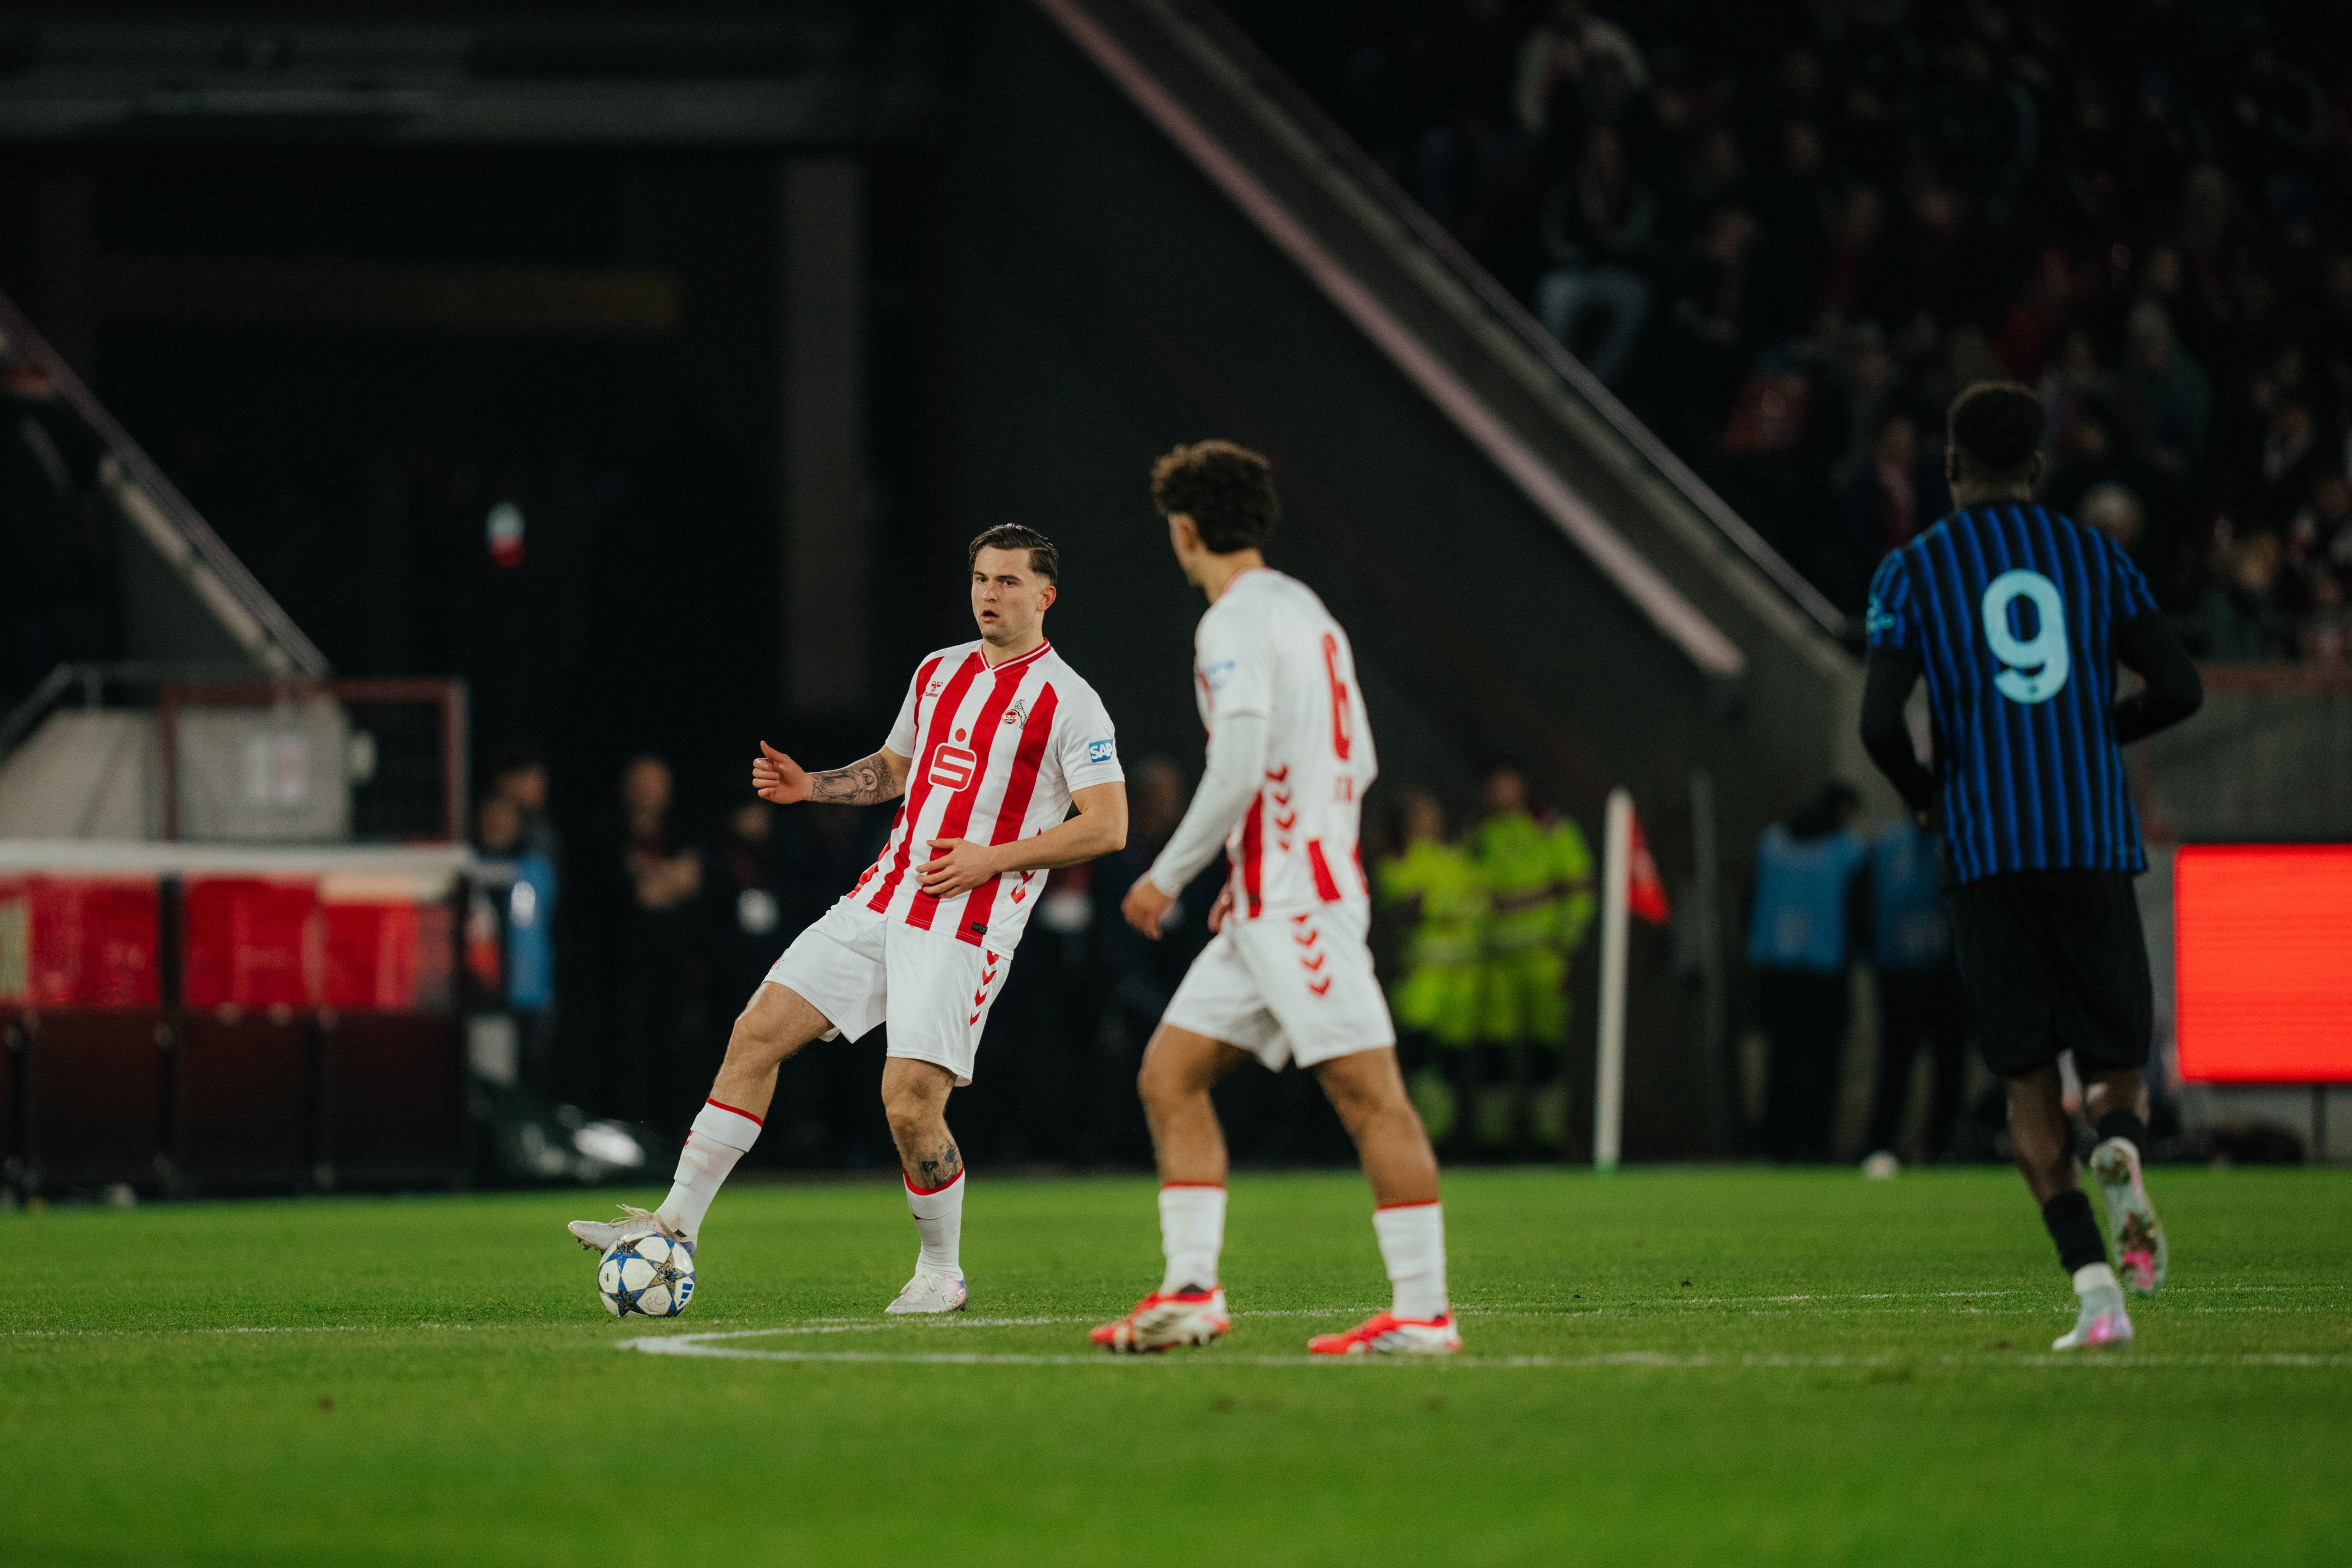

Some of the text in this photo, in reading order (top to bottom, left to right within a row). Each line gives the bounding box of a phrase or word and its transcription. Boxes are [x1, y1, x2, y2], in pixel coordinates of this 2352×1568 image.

[1322, 633, 1351, 761] 6
[1981, 568, 2069, 704] 9
[1090, 742, 1114, 760] SAP
